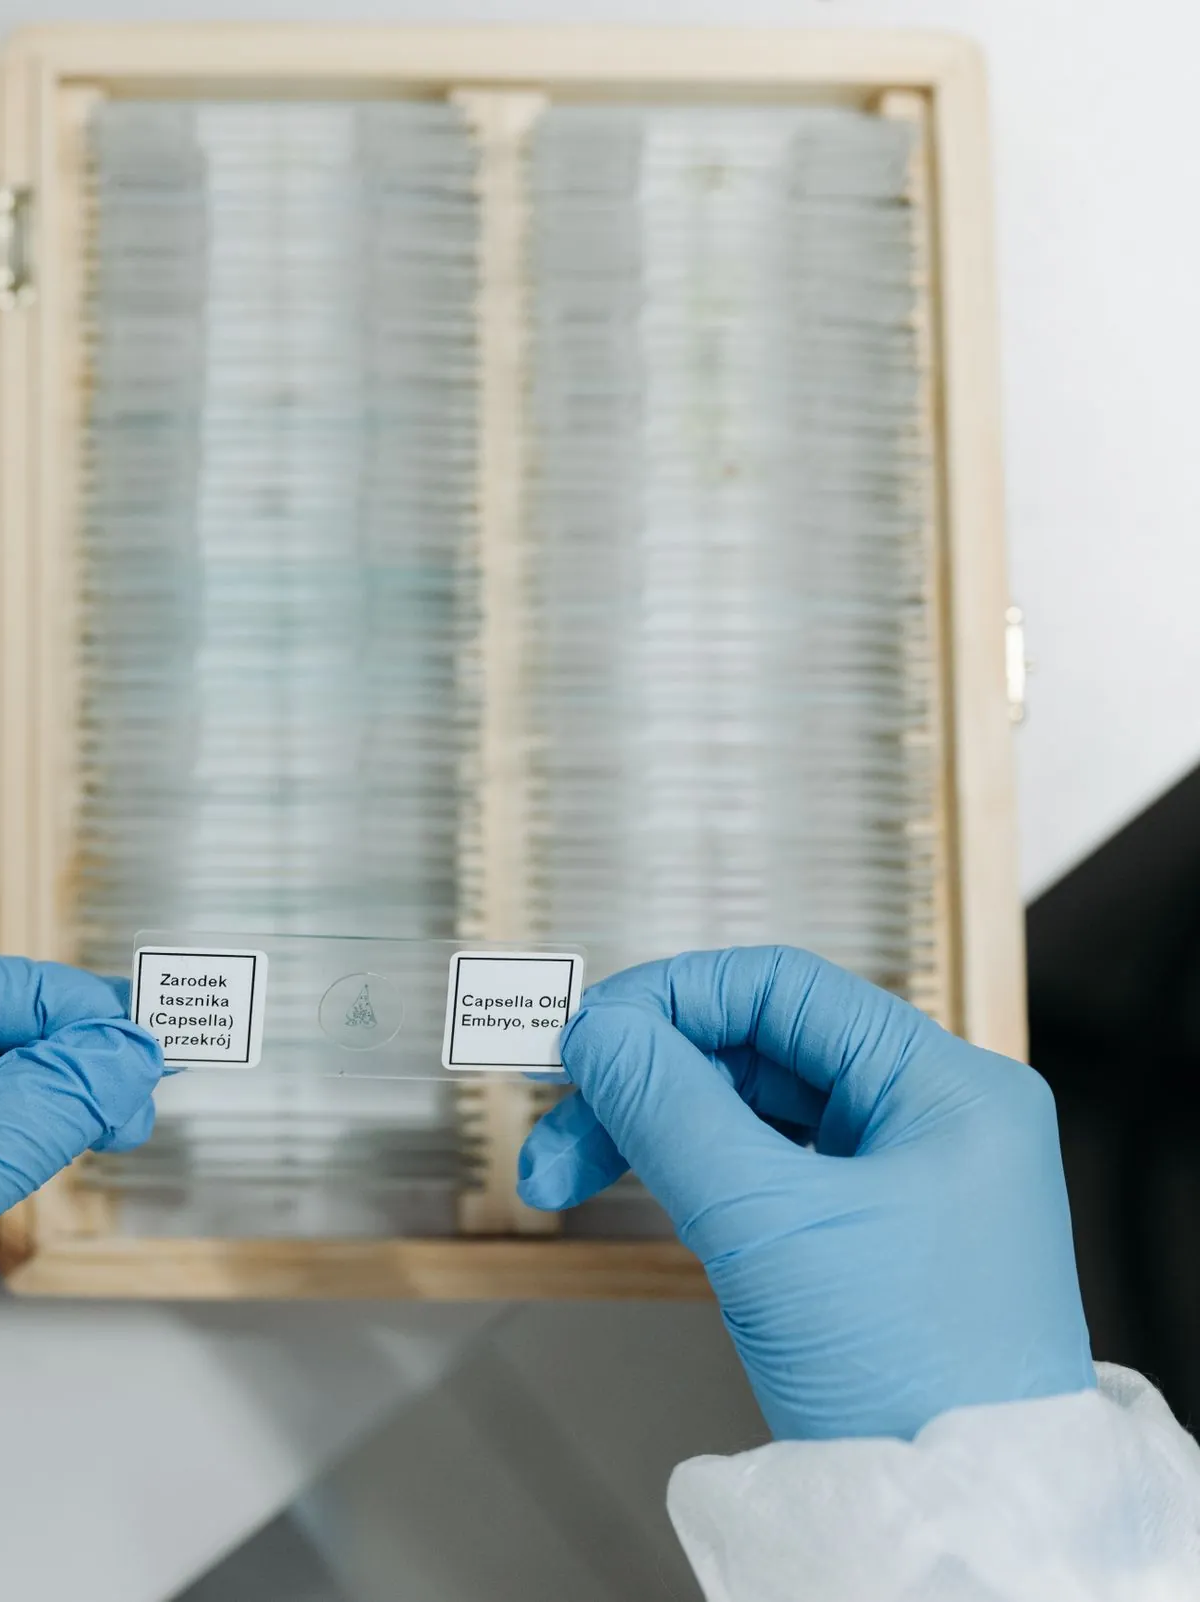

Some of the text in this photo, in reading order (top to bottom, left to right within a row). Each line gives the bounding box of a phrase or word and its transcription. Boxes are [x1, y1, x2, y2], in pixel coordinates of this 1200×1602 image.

[160, 973, 227, 987] Zarodek
[160, 994, 229, 1007] tasznika
[462, 994, 567, 1010] Capsella Old
[149, 1012, 234, 1030] (Capsella)
[461, 1014, 563, 1030] Embryo, sec.
[164, 1033, 231, 1049] przekrój
